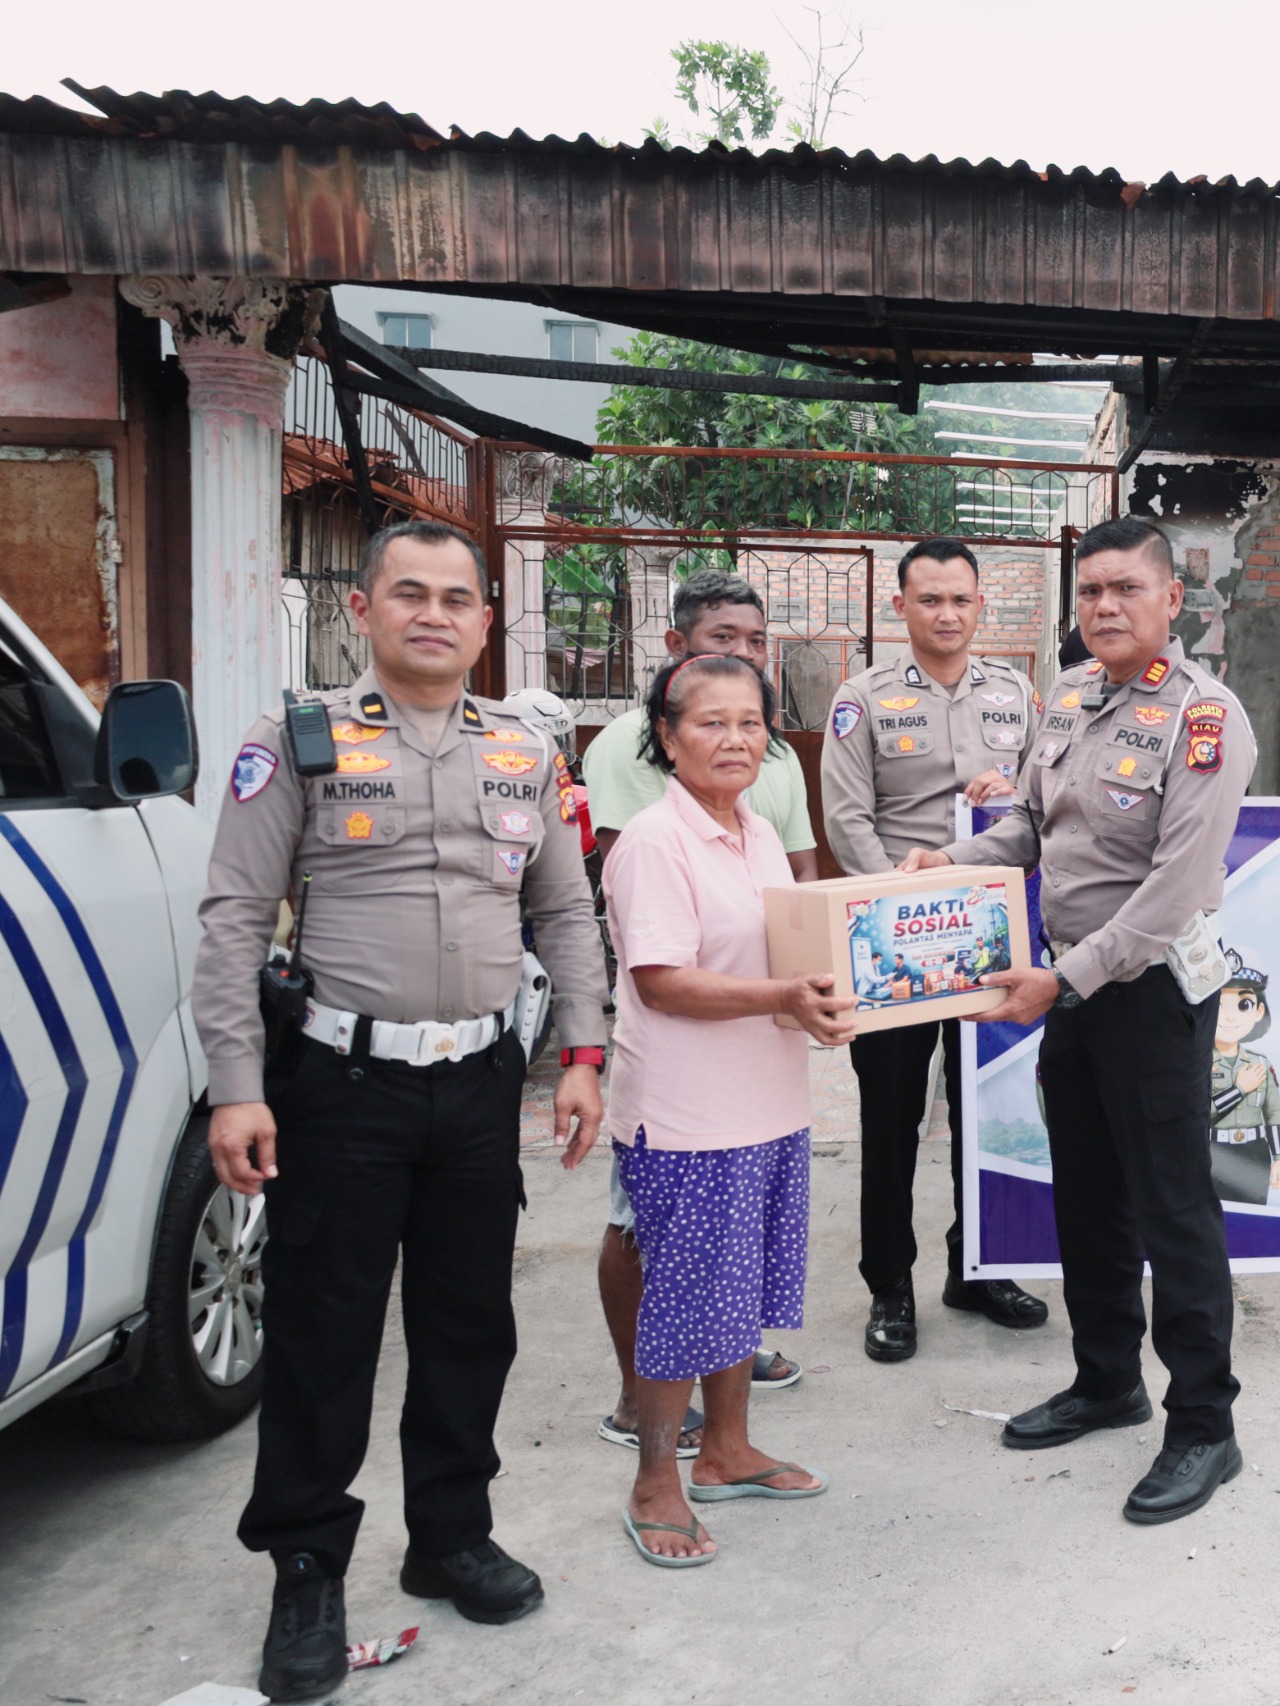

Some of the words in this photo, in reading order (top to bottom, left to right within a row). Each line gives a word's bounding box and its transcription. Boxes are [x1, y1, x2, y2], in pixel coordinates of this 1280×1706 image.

[878, 717, 896, 730] TRI
[899, 715, 928, 728] AGUS
[982, 711, 1021, 725] POLRI
[1046, 716, 1075, 731] IRSAN
[1192, 724, 1219, 732] RIAU
[1114, 729, 1163, 752] POLRI
[323, 781, 396, 800] M.THOHA
[483, 780, 537, 802] POLRI
[894, 913, 973, 938] SOSIAL
[893, 934, 934, 947] POLANTAS
[937, 929, 973, 940] MENYAPA
